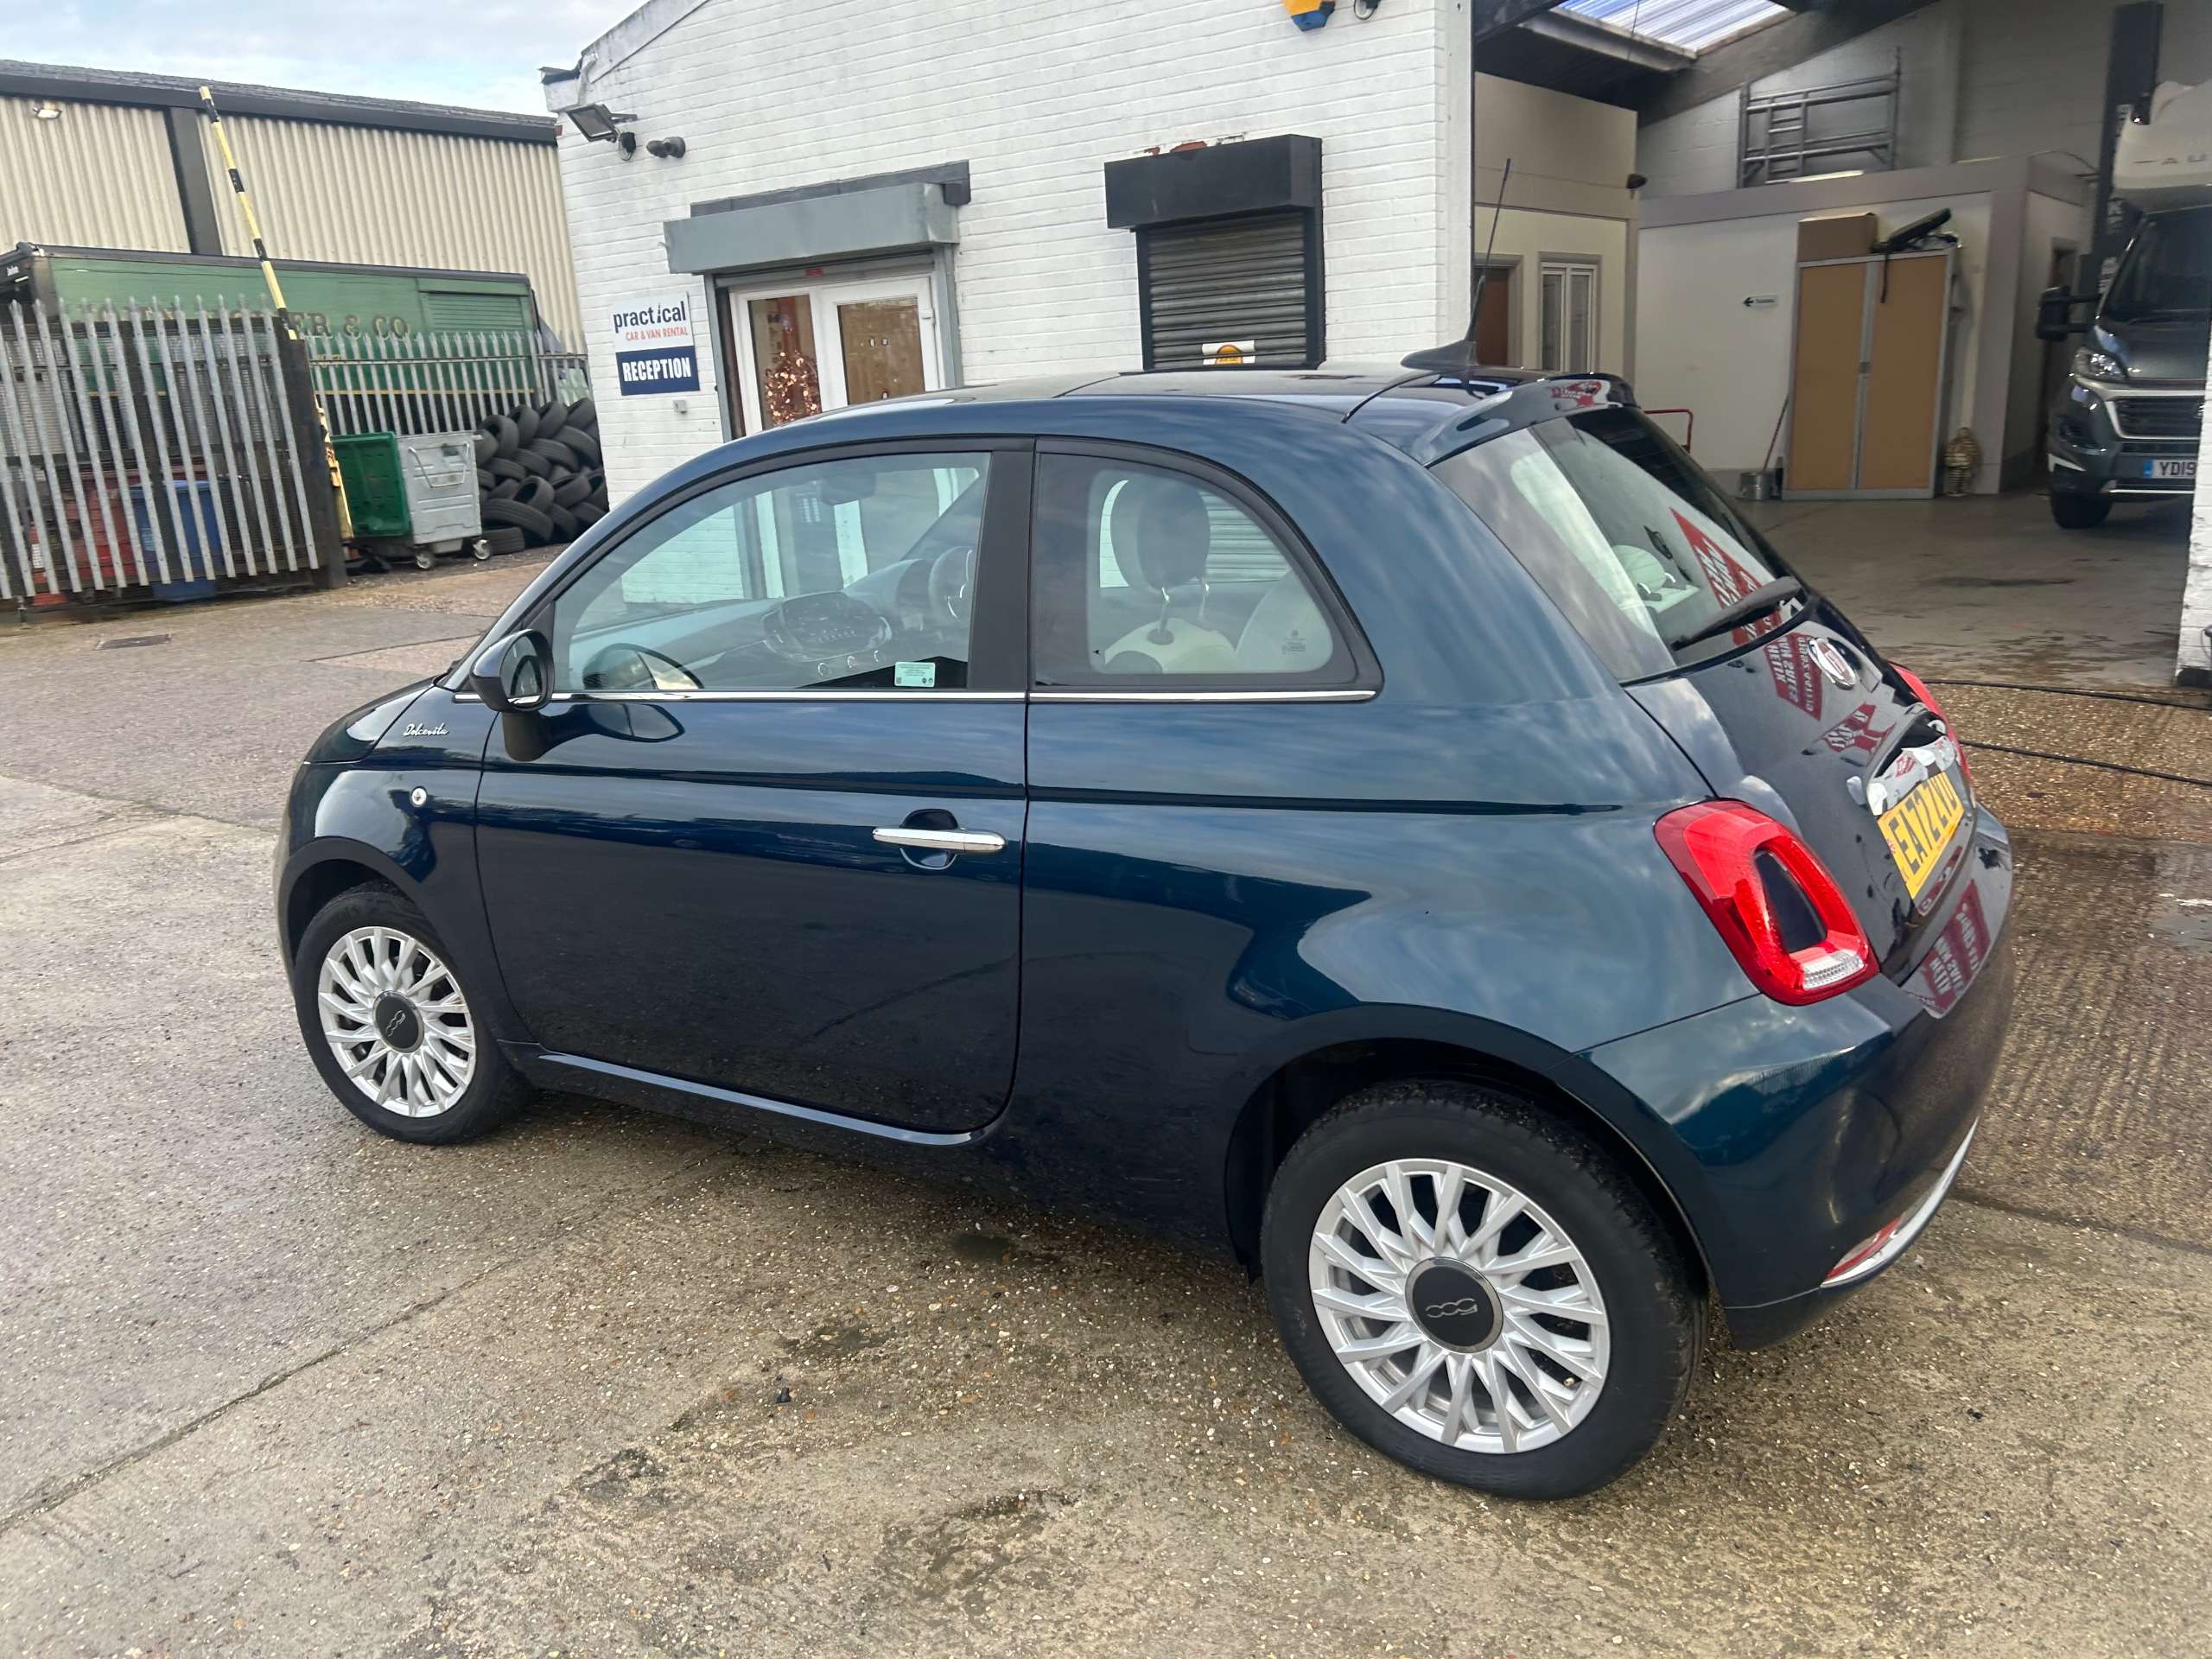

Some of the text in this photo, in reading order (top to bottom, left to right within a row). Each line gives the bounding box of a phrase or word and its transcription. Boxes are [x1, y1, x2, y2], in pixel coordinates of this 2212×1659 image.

[613, 301, 687, 334] practical
[626, 327, 689, 341] CAR & VAN RENTAL
[622, 357, 691, 382] RECEPTION
[403, 722, 450, 736] Dolcevita
[1888, 787, 1942, 876] EA72
